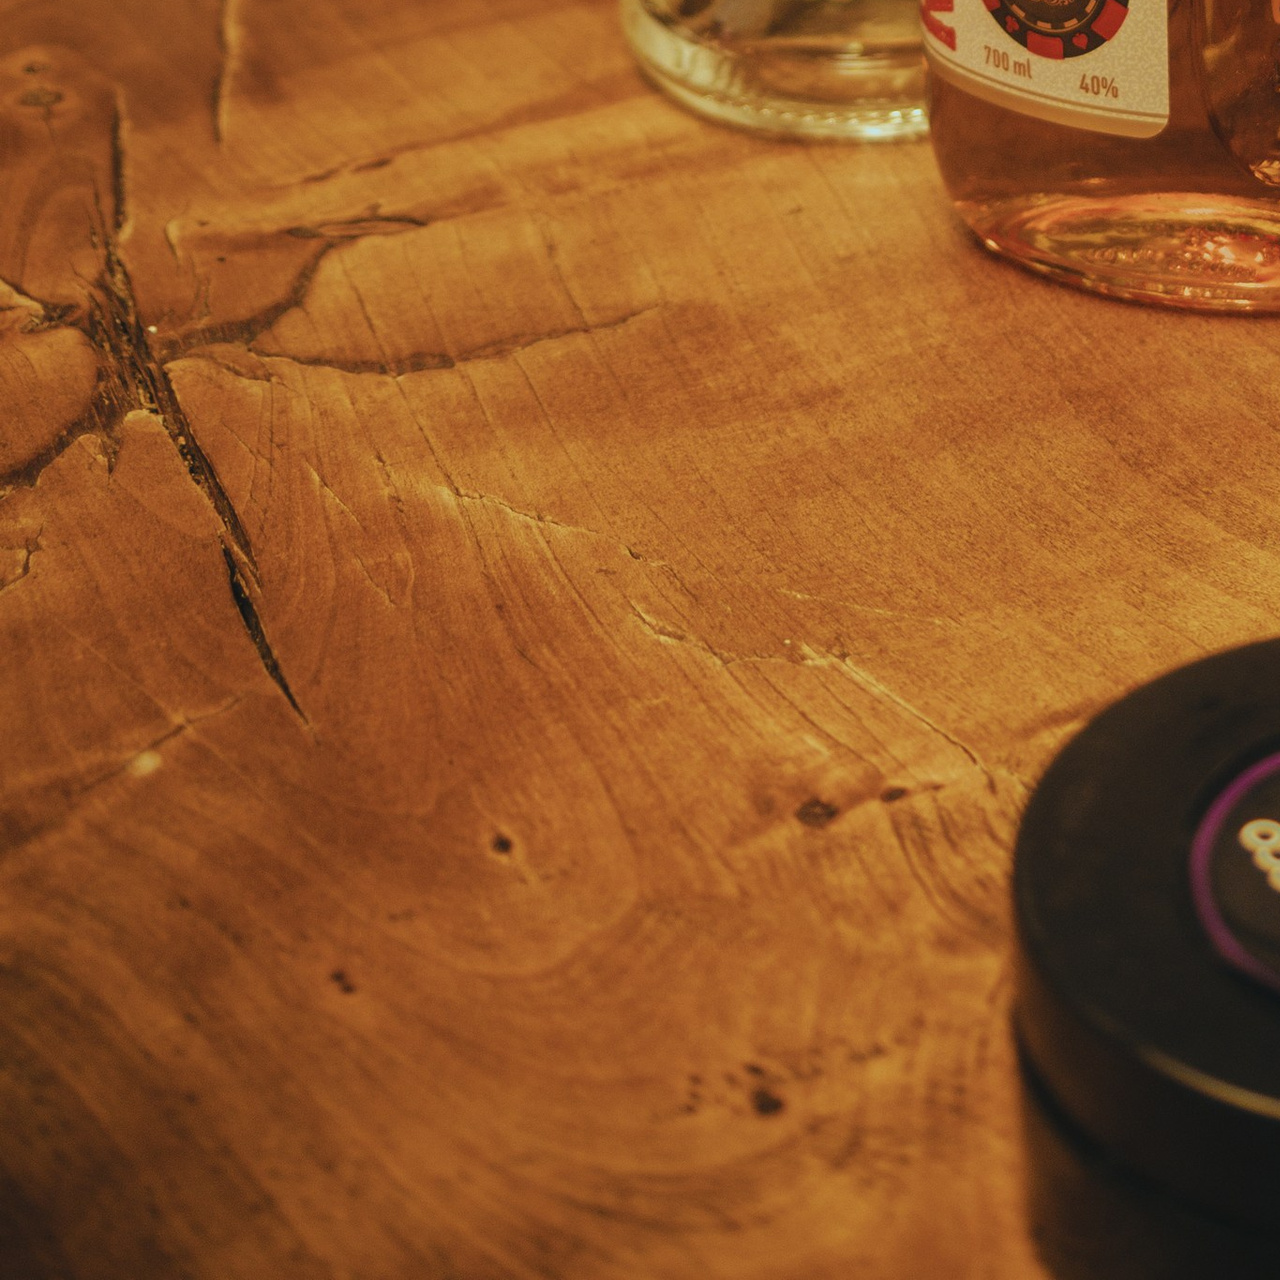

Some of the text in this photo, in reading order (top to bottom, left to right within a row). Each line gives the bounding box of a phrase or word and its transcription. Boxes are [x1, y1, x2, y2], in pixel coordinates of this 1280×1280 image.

[984, 44, 1119, 99] 700 ml 40%
